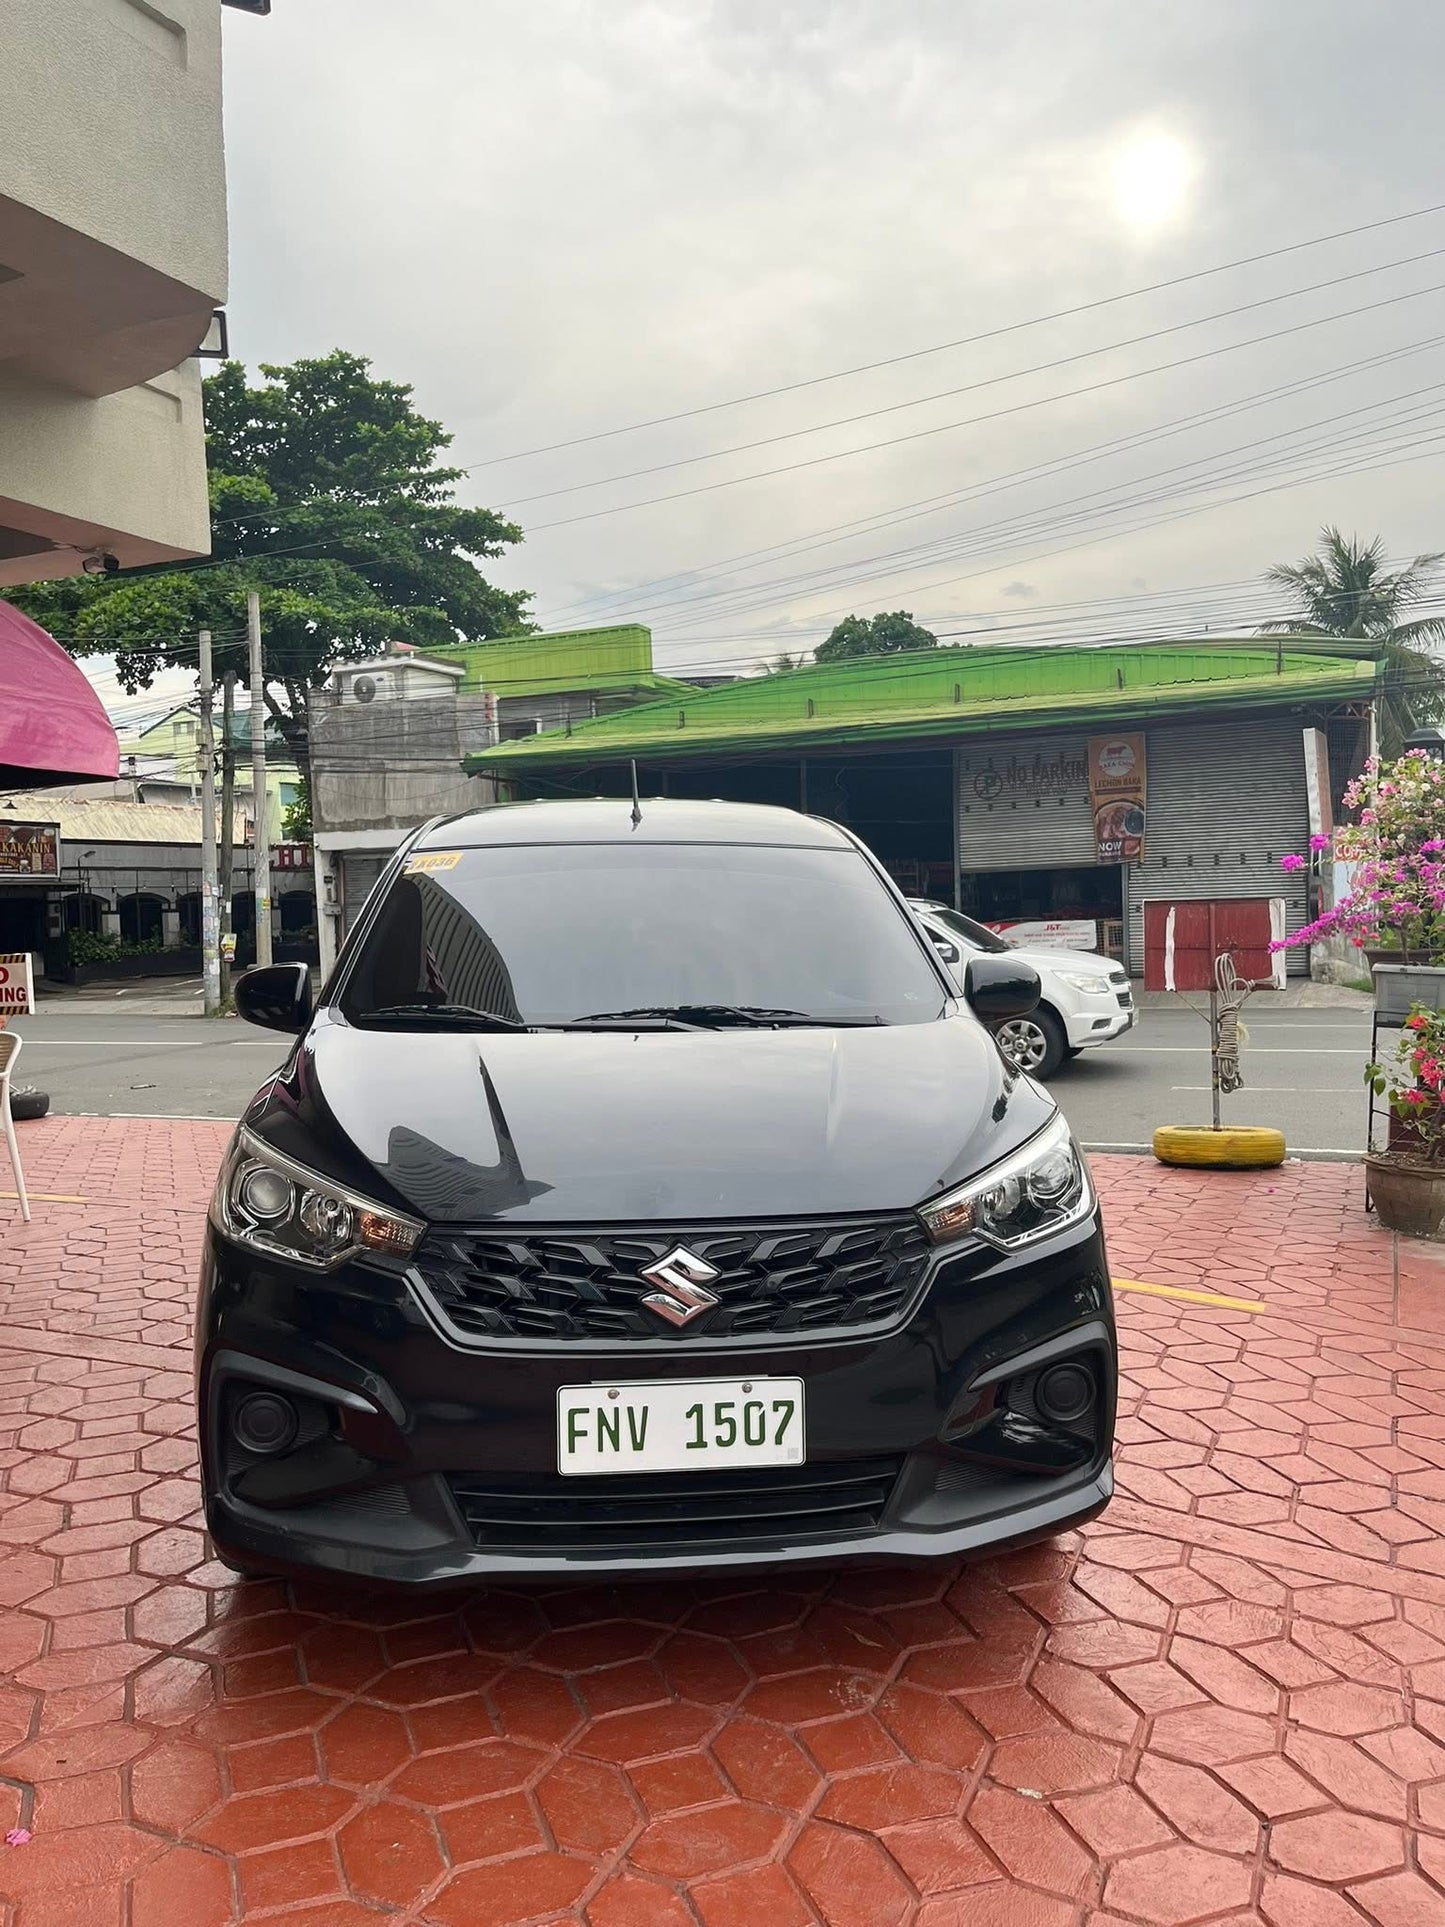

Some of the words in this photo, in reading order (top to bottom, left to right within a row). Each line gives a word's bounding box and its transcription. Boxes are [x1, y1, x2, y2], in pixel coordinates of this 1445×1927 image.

[1032, 760, 1089, 782] PARKIN
[2, 842, 50, 854] KAKANIN
[1099, 841, 1121, 851] NOW
[0, 967, 9, 985] O
[0, 987, 26, 1002] ING
[567, 1405, 649, 1454] FNV
[685, 1399, 795, 1449] 1507
